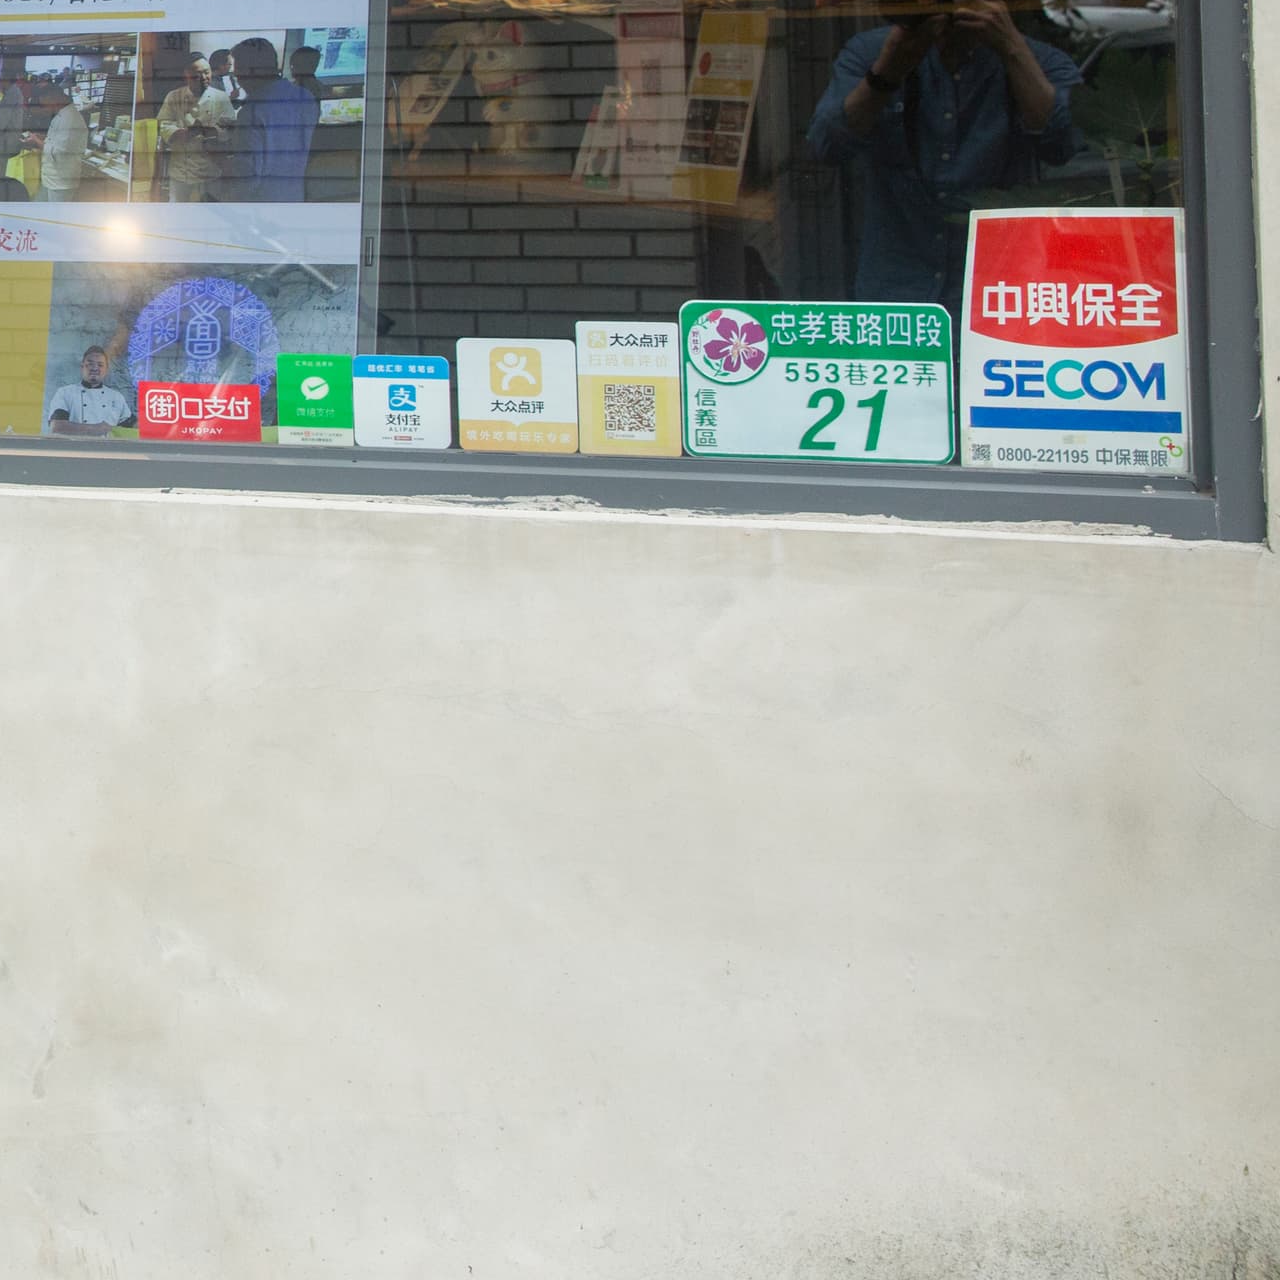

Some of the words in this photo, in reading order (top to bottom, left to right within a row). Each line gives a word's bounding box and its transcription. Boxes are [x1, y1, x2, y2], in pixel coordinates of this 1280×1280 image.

[982, 281, 1162, 327] 中興保全
[609, 333, 668, 348] 大众点评
[771, 310, 942, 348] 忠孝東路四段
[785, 362, 937, 387] 553巷22弄
[983, 359, 1166, 401] SECOM
[148, 395, 252, 420] 街口支付
[385, 413, 421, 426] 支付宝
[490, 400, 545, 414] 大众点评
[694, 388, 718, 447] 信義區
[798, 388, 888, 451] 21
[181, 426, 223, 435] JKOPAY
[997, 448, 1089, 463] 0800-221195
[1096, 448, 1169, 467] 中保無限
